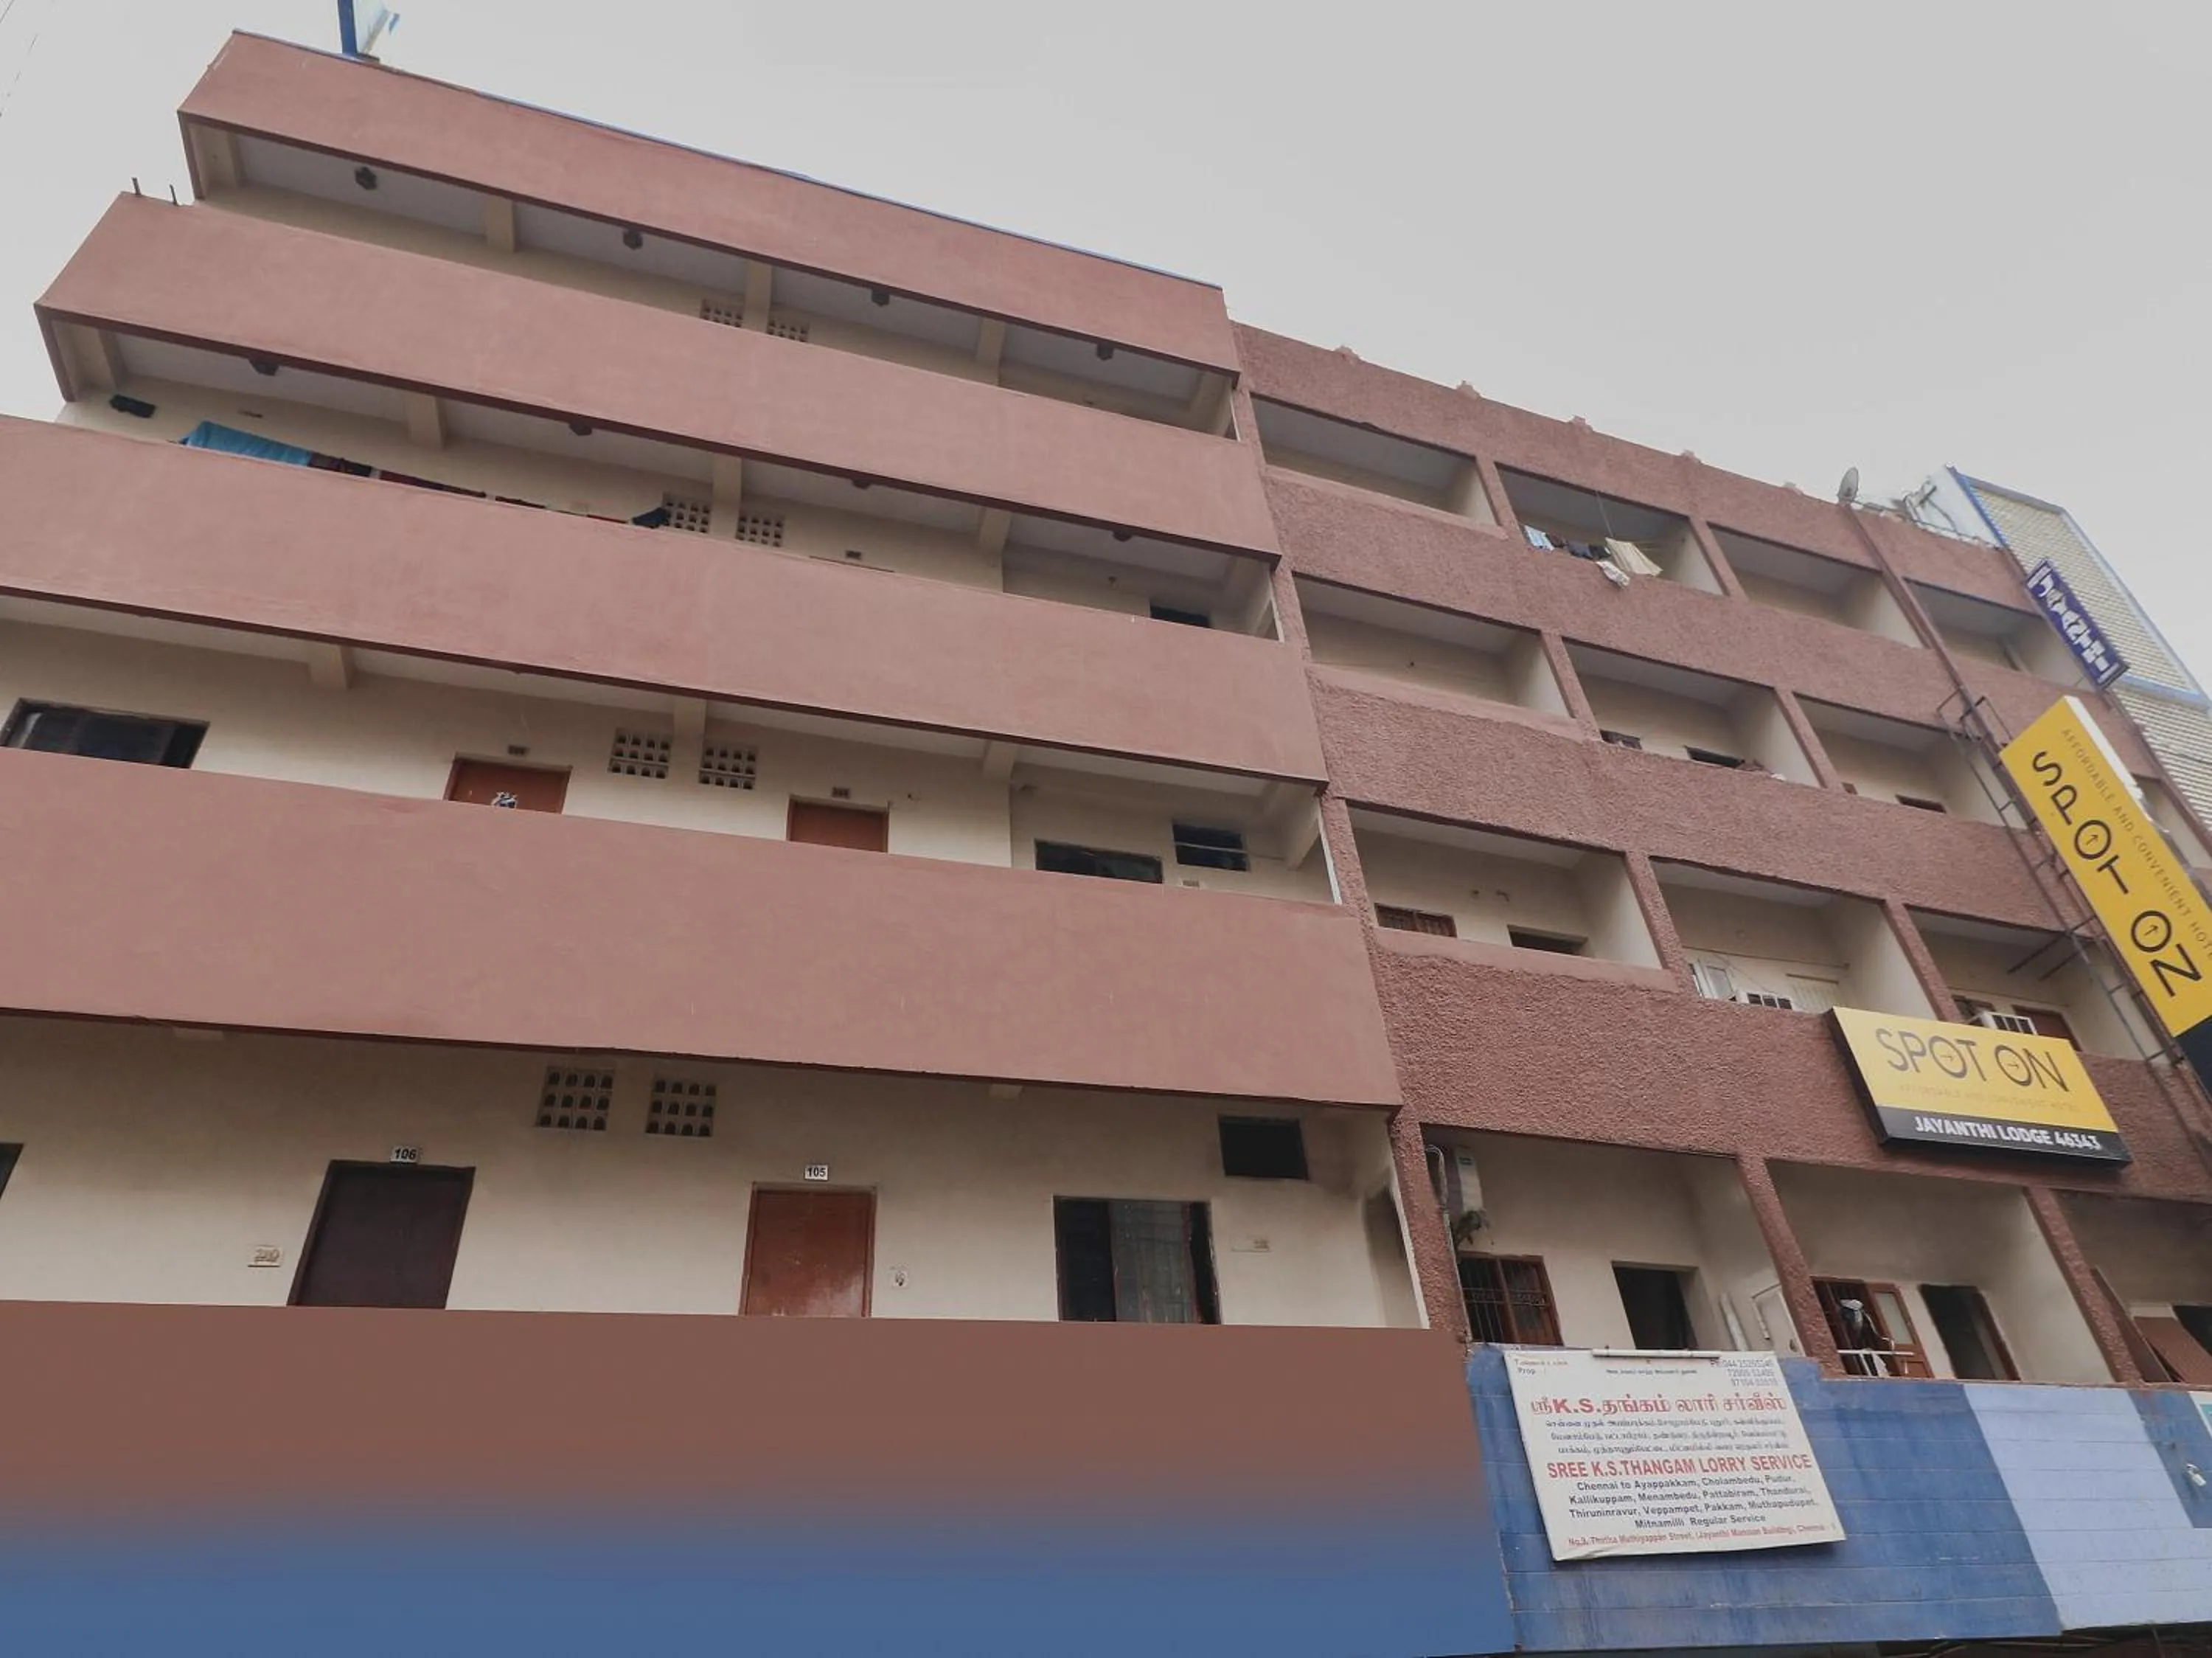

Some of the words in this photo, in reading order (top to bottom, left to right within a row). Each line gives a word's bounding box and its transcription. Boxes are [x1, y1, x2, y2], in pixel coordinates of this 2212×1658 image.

[2113, 805, 2135, 834] AND
[2031, 750, 2129, 895] SPOT
[2130, 909, 2202, 998] ON
[1875, 1027, 1986, 1082] SPOT
[1994, 1044, 2070, 1092] ON
[1914, 1115, 1997, 1140] JAYANTHI
[2001, 1123, 2051, 1146] LODGE
[394, 1148, 417, 1160] 106
[807, 1167, 827, 1178] 105
[1548, 1461, 1588, 1478] SREE
[1591, 1457, 1695, 1478] K.S.THANGAM
[1699, 1457, 1747, 1473] LORRY
[1750, 1454, 1812, 1471] SERVICE
[1577, 1481, 1618, 1491] Chennai
[1689, 1516, 1727, 1527] Regular
[1730, 1514, 1766, 1524] Service
